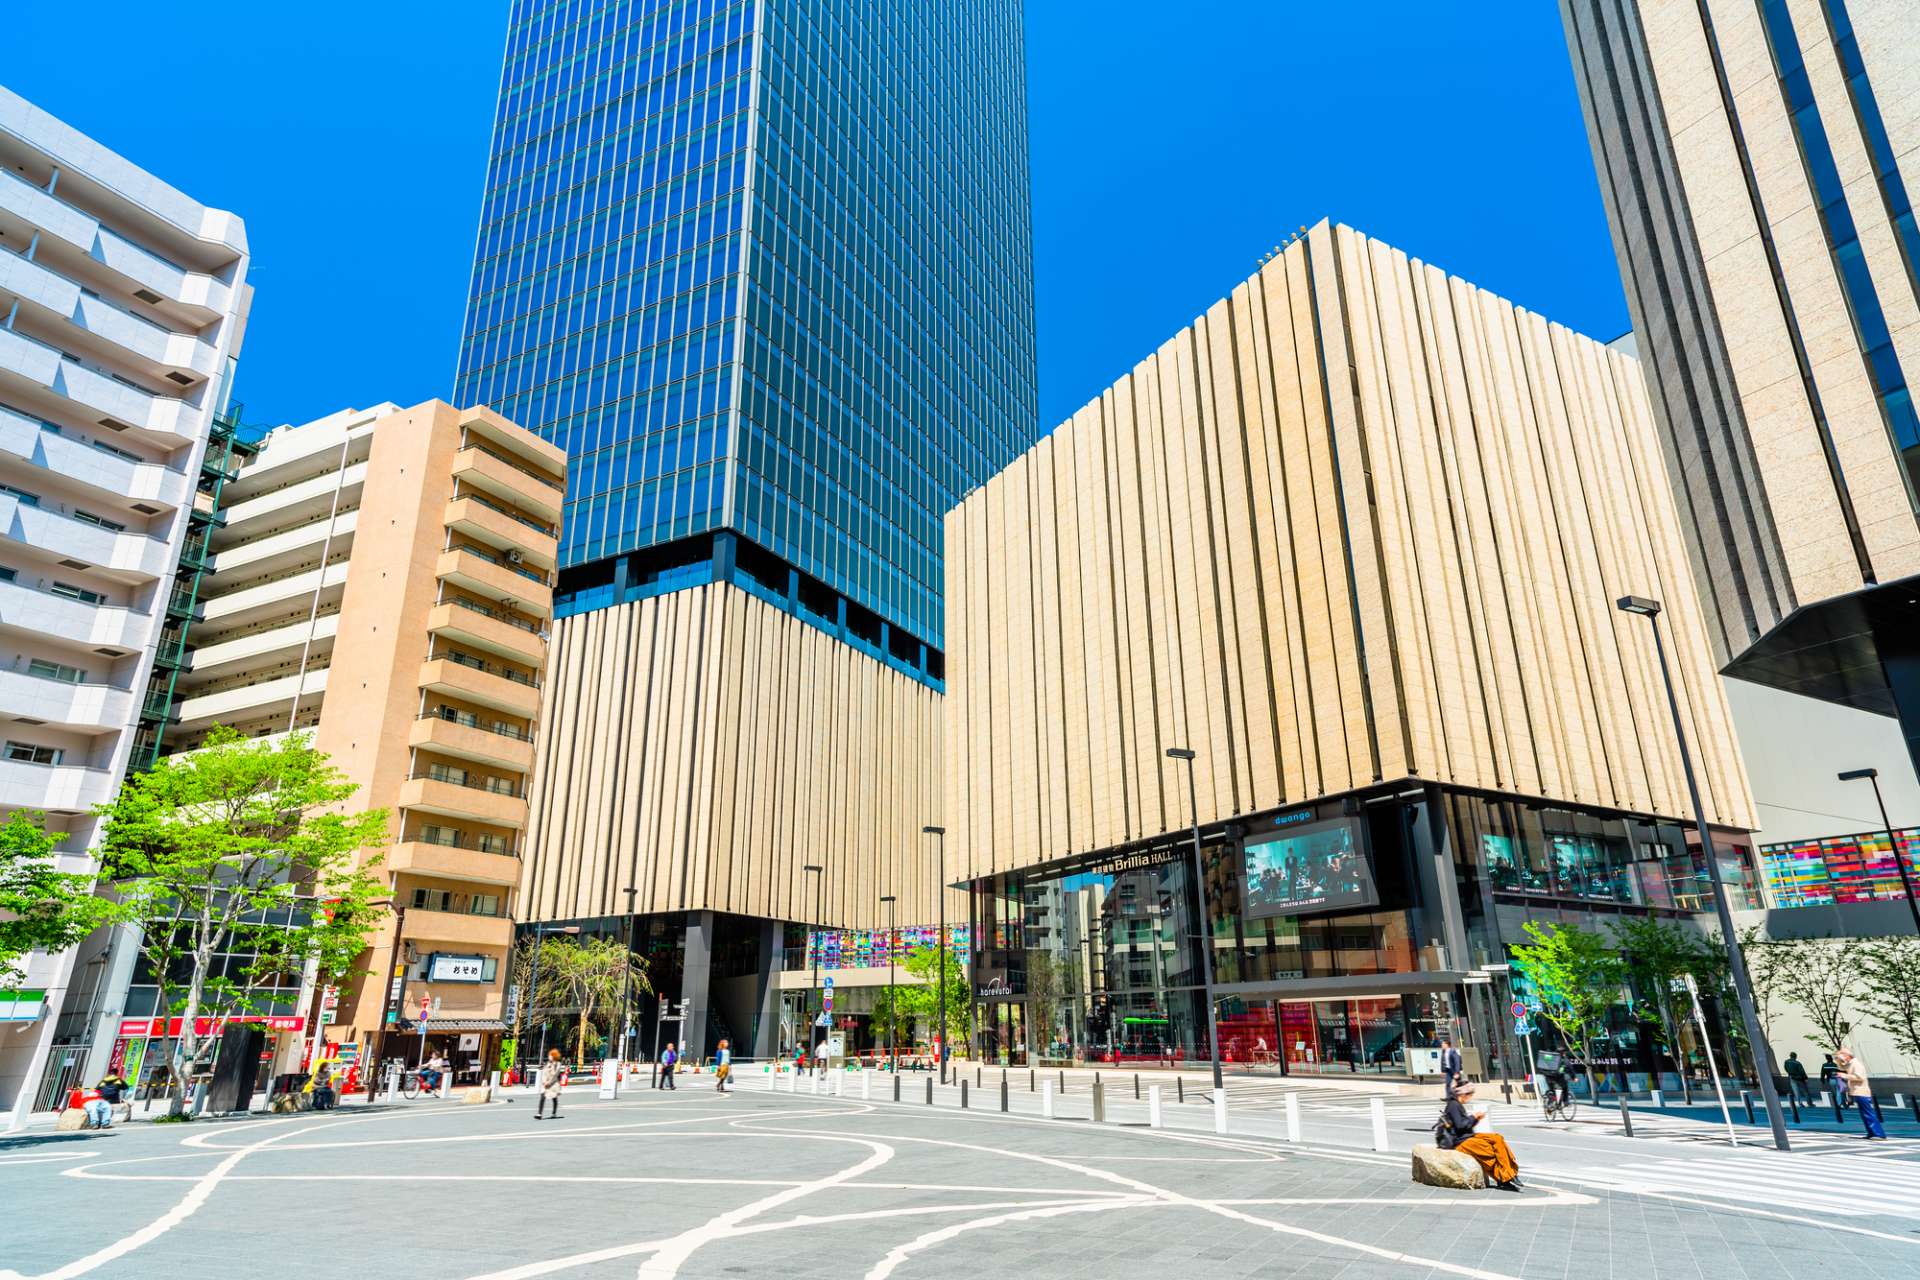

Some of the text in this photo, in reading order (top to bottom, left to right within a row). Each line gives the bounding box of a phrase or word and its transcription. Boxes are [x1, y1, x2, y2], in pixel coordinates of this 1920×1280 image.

[1275, 811, 1311, 824] dwango
[1114, 855, 1149, 871] Brillia
[1151, 850, 1173, 864] HALL
